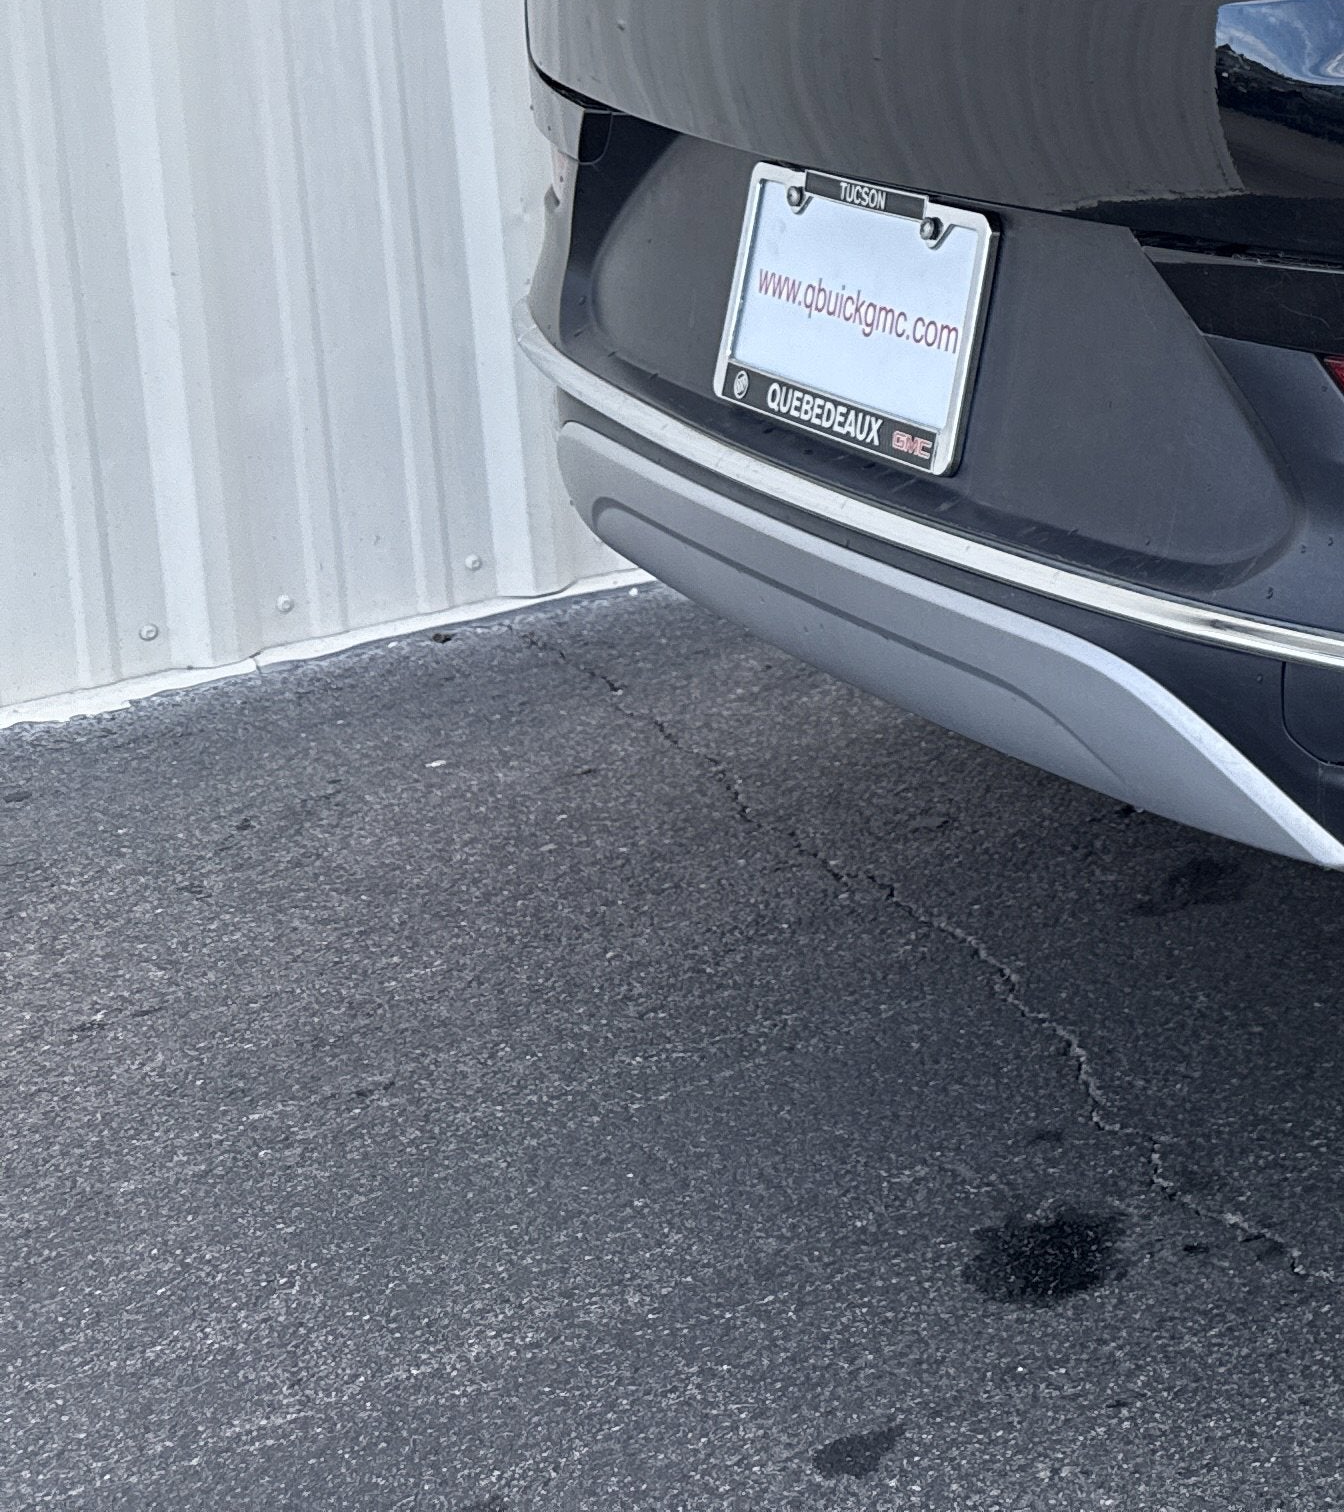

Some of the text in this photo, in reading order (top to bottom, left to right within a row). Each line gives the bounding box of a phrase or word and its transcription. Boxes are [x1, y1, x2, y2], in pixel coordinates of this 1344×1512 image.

[839, 181, 887, 211] TUCSON
[758, 268, 959, 354] www.qbuickgmc.com
[767, 382, 933, 460] QUEBEDEAUX GMC
